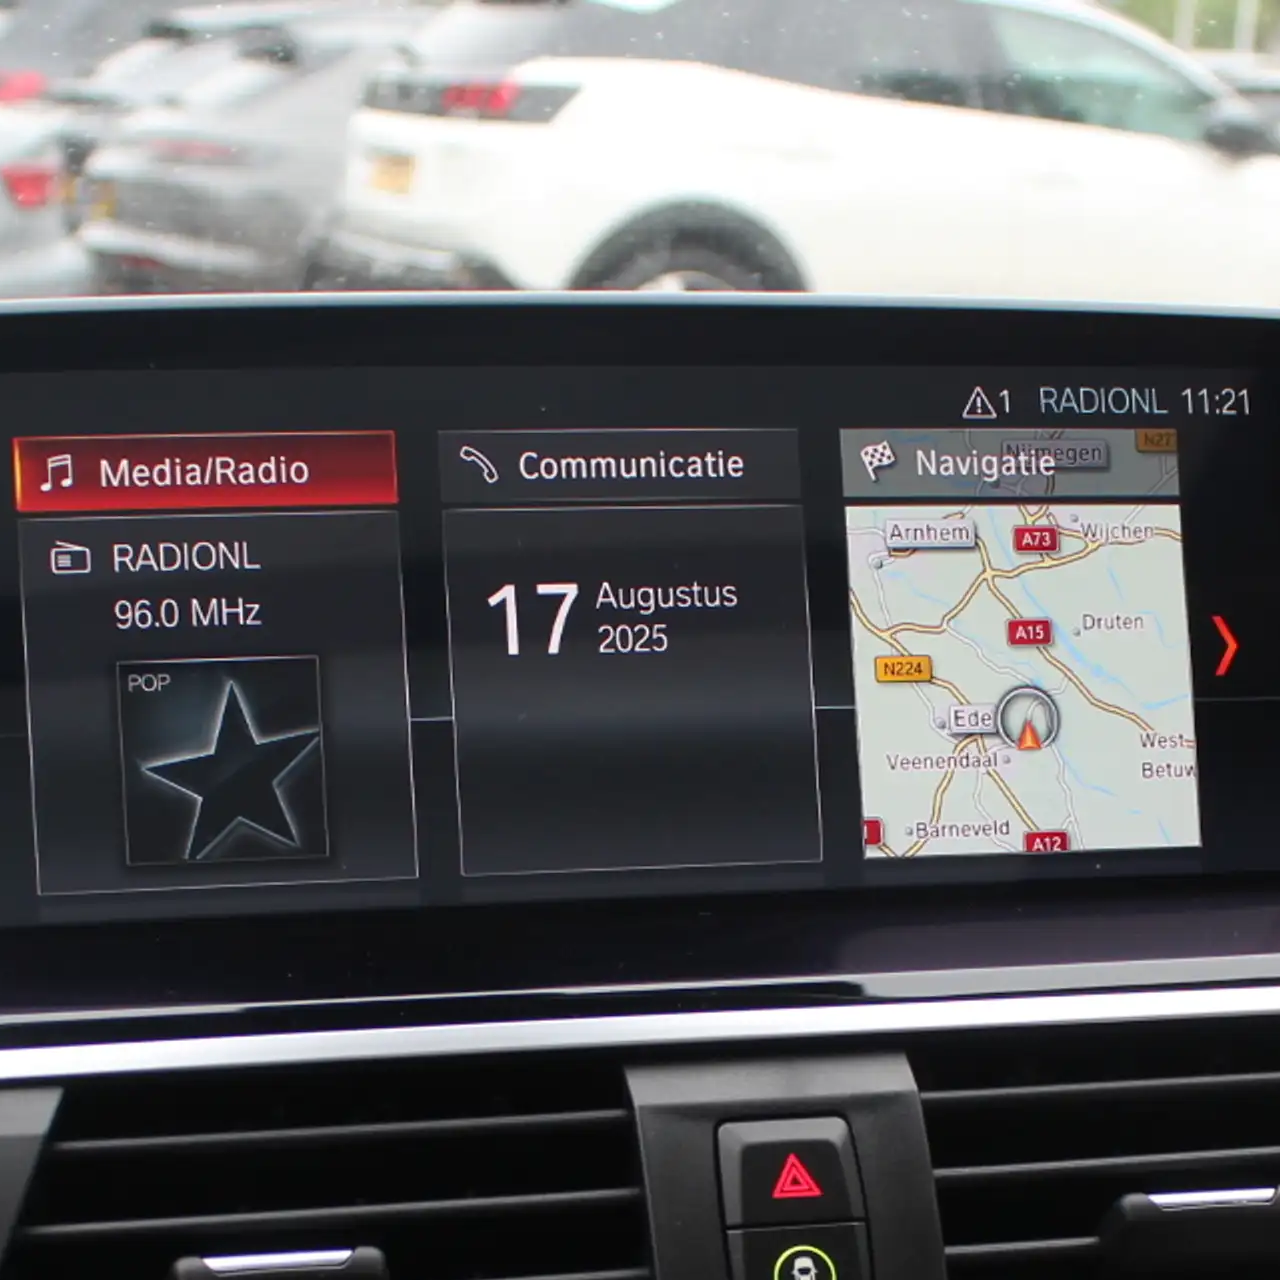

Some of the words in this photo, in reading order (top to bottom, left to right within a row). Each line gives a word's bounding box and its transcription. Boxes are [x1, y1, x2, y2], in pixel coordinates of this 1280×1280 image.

[998, 389, 1010, 414] 1
[1039, 387, 1169, 414] RADIONL
[1181, 388, 1251, 415] 11:21
[99, 456, 310, 488] Media/Radio
[519, 450, 745, 480] Communicatie
[916, 449, 1056, 481] Navigatie
[889, 523, 970, 542] Arnhem
[1022, 531, 1051, 547] A73
[1080, 523, 1154, 542] Wijchen
[113, 541, 261, 572] RADIONL
[596, 581, 738, 615] Augustus
[114, 599, 180, 629] 96.0
[191, 598, 262, 627] MHz
[487, 582, 579, 655] 17
[1082, 614, 1144, 631] Druten
[598, 624, 668, 653] 2025
[1015, 624, 1045, 641] A15
[883, 661, 924, 678] N224
[127, 674, 171, 694] POP
[953, 710, 992, 728] Ede
[886, 752, 998, 771] Veenendaal
[916, 820, 1010, 839] Barneveld
[1032, 836, 1062, 851] A12
